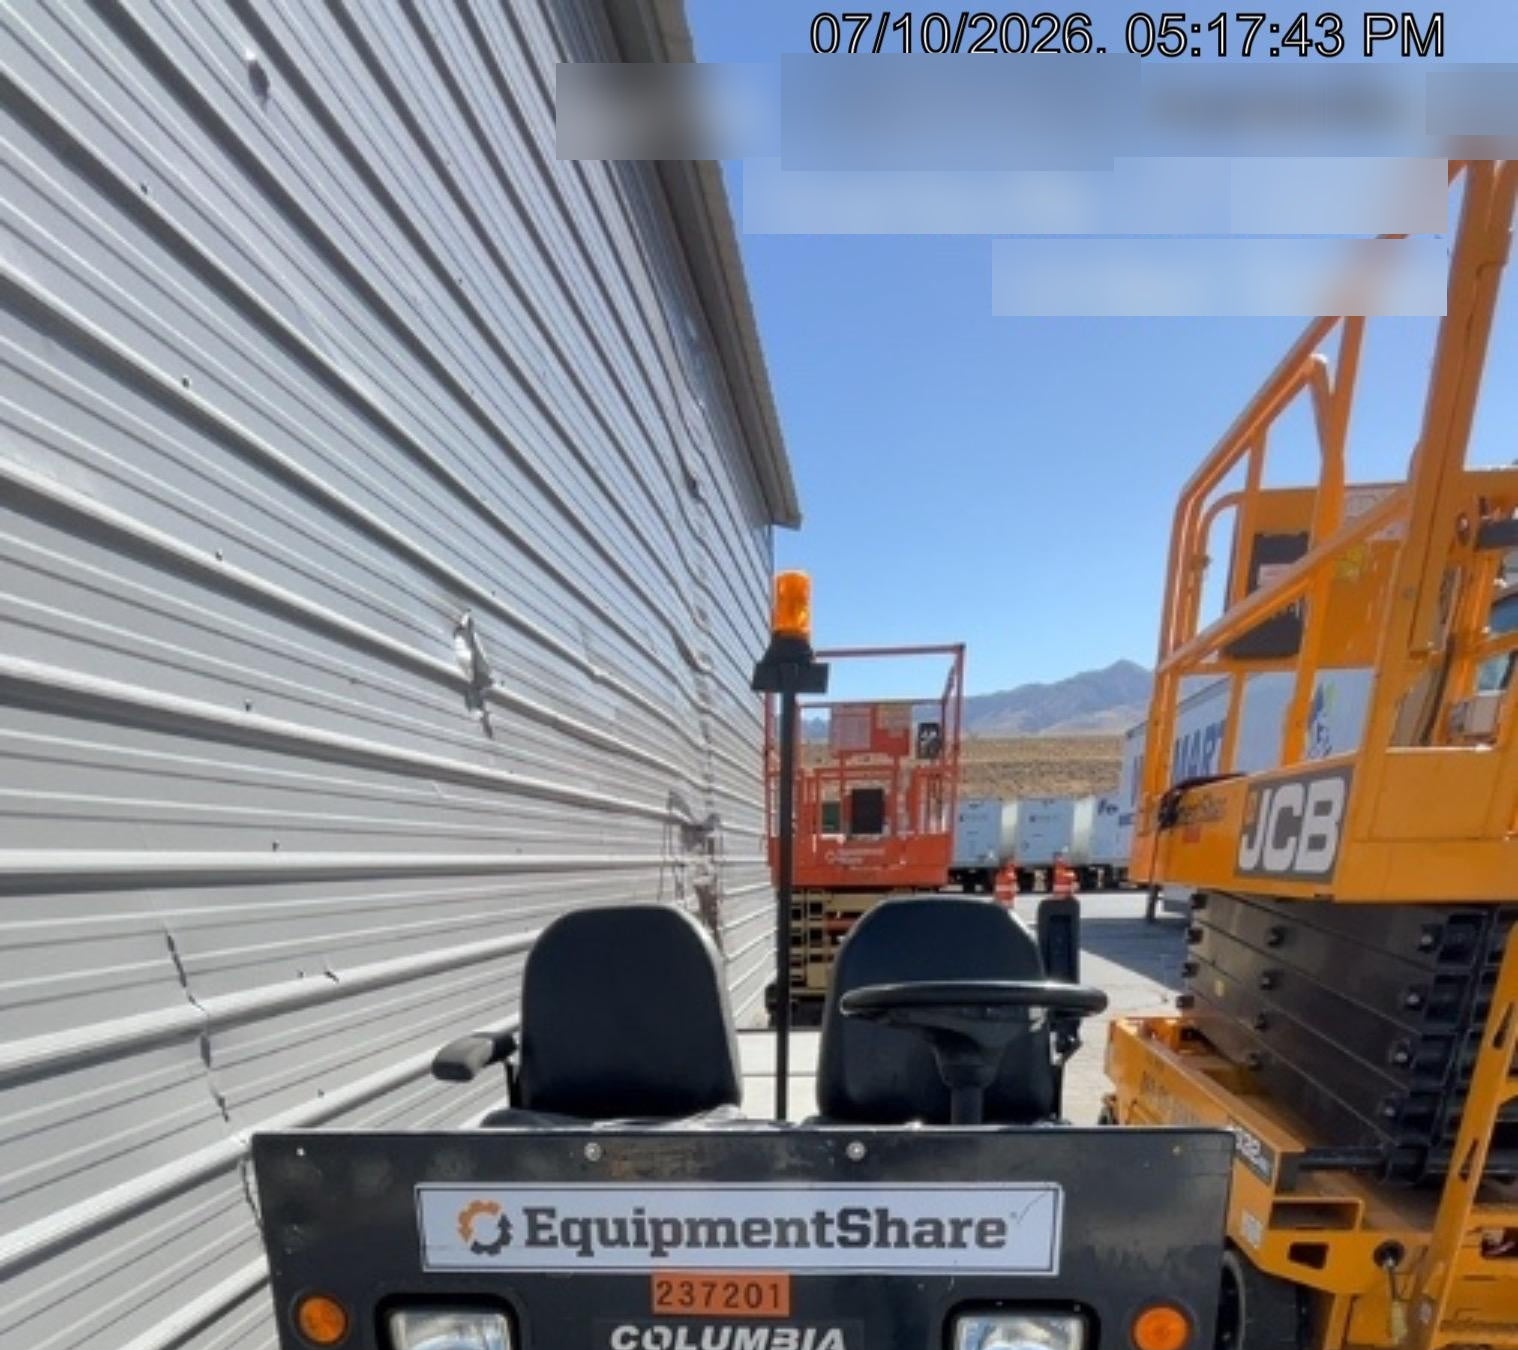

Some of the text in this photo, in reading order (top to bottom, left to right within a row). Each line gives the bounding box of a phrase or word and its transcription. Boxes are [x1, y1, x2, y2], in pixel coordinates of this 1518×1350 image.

[1238, 776, 1346, 873] JCB
[523, 1206, 1008, 1257] EquipmentShare
[656, 1279, 780, 1309] 237201
